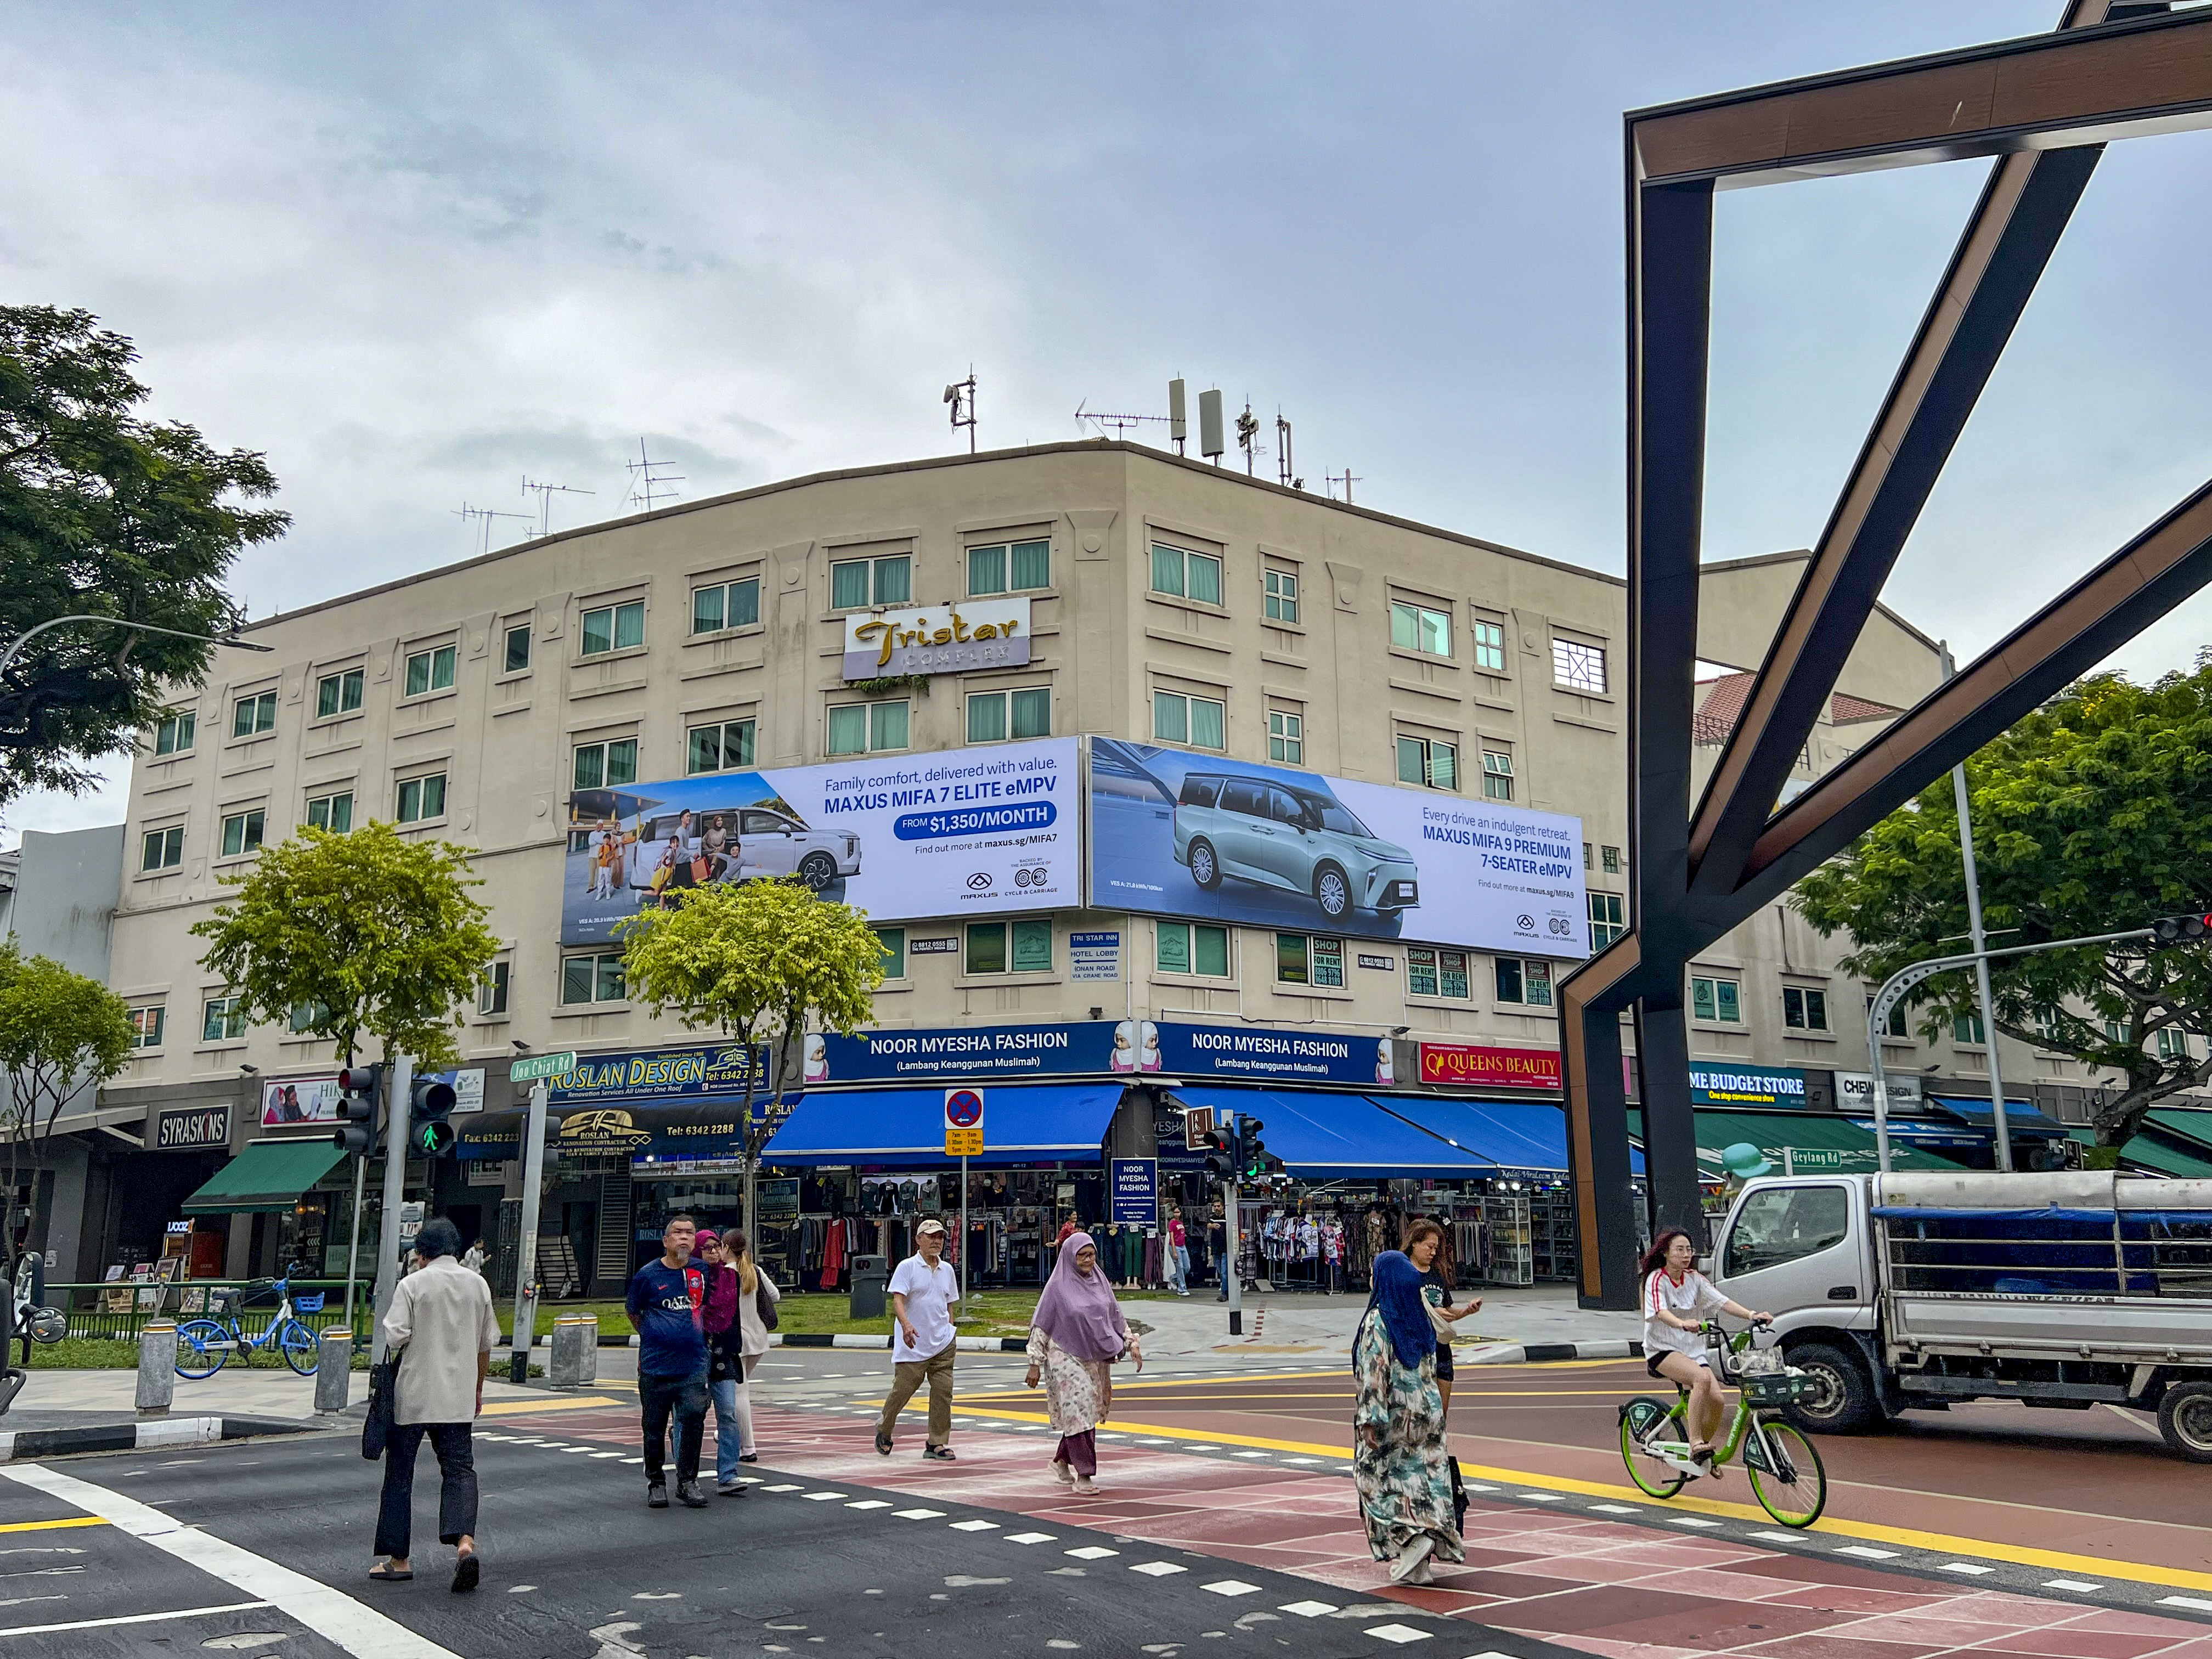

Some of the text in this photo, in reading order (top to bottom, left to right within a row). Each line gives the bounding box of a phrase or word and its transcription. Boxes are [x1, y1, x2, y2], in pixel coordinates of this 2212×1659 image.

[855, 613, 1018, 666] Tristar
[906, 646, 1010, 666] COMPLEX
[826, 758, 1057, 792] Family comfort, delivered with value.
[825, 776, 1057, 814] MAXUS MIFA 7 ELITE eMPV
[902, 806, 1048, 833] FROM $1,350/MONTH
[1423, 807, 1571, 842] Every drive an indulgent retreat.
[915, 833, 1057, 854] Find out more at maxus.sg/MIFA7
[1423, 825, 1571, 860] MAXUS MIFA 9 PREMIUM
[1481, 854, 1572, 879] 7-SEATER eMPV
[1478, 879, 1492, 888] Find
[1492, 882, 1503, 890] out
[1526, 888, 1575, 899] maxus.sg/MIFA9
[1314, 939, 1339, 951] SHOP
[1313, 955, 1340, 966] FOR RENT
[1409, 950, 1432, 961] SHOP
[1409, 965, 1435, 977] FOR RENT
[1440, 970, 1466, 981] FOR RENT
[1526, 979, 1550, 989] FOR RENT
[871, 1032, 1068, 1055] NOOR MYESHA FASHION
[1192, 1034, 1348, 1058] NOOR MYESHA FASHION
[514, 1056, 569, 1079] Joo Chiat Rd
[896, 1056, 1041, 1073] (Lambang Keanggunan Muslimah)
[1215, 1058, 1329, 1075] (Lambang Keanggunan Muslimah)
[1448, 1053, 1556, 1075] QUEENS BEAUTY
[550, 1059, 705, 1091] ROSLAN DESIGN
[706, 1070, 742, 1081] Tel: 6342
[1709, 1073, 1804, 1094] BUDGET STORE
[1708, 1090, 1720, 1099] One
[1732, 1093, 1762, 1102] convenience
[1762, 1094, 1775, 1103] store
[1885, 1086, 1911, 1096] ESIGN
[161, 1111, 224, 1145] SYRASKINS
[464, 1134, 503, 1142] Fax: 6342
[580, 1131, 610, 1139] ROSLAN
[667, 1124, 734, 1136] Tel: 6342 2288
[1792, 1150, 1825, 1165] Geylang
[1827, 1152, 1838, 1164] Rd
